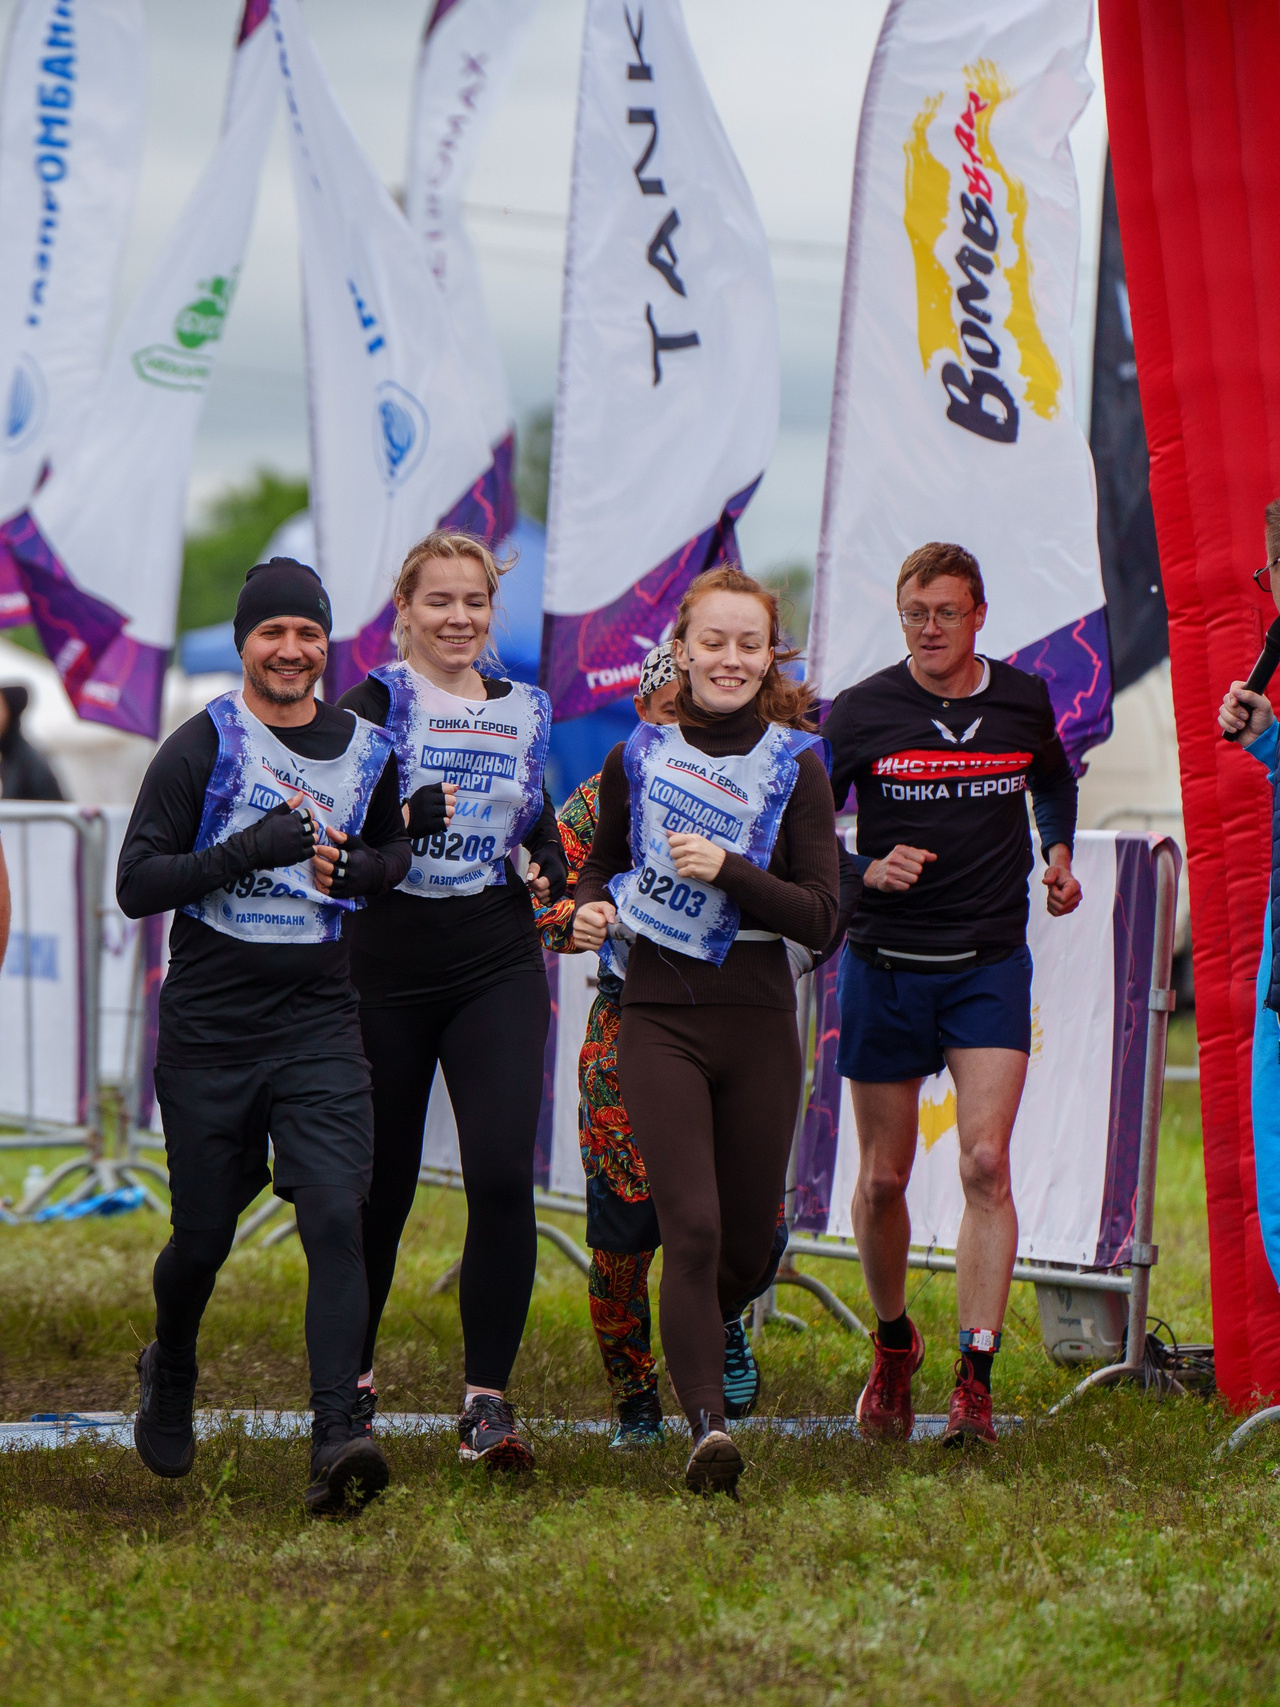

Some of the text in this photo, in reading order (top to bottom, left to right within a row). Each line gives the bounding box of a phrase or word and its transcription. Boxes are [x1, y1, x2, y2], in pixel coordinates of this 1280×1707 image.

[624, 0, 700, 388] TANK
[586, 662, 640, 690] ГОНК
[429, 718, 518, 736] ГОНКА ГЕРОЕВ
[422, 749, 515, 777] КОМАНДНЫЙ
[446, 770, 490, 791] СТАРТ
[667, 757, 749, 801] ГОНКА ГЕРОЕВ
[881, 774, 1026, 800] ГОНКА ГЕРОЕВ
[650, 780, 742, 840] КОМАНДНЫЙ
[411, 832, 496, 864] 09208
[636, 866, 707, 918] 9203
[236, 913, 305, 926] ГАЗПРОМБАНК
[628, 904, 692, 943] ГАЗПРОМБАНК
